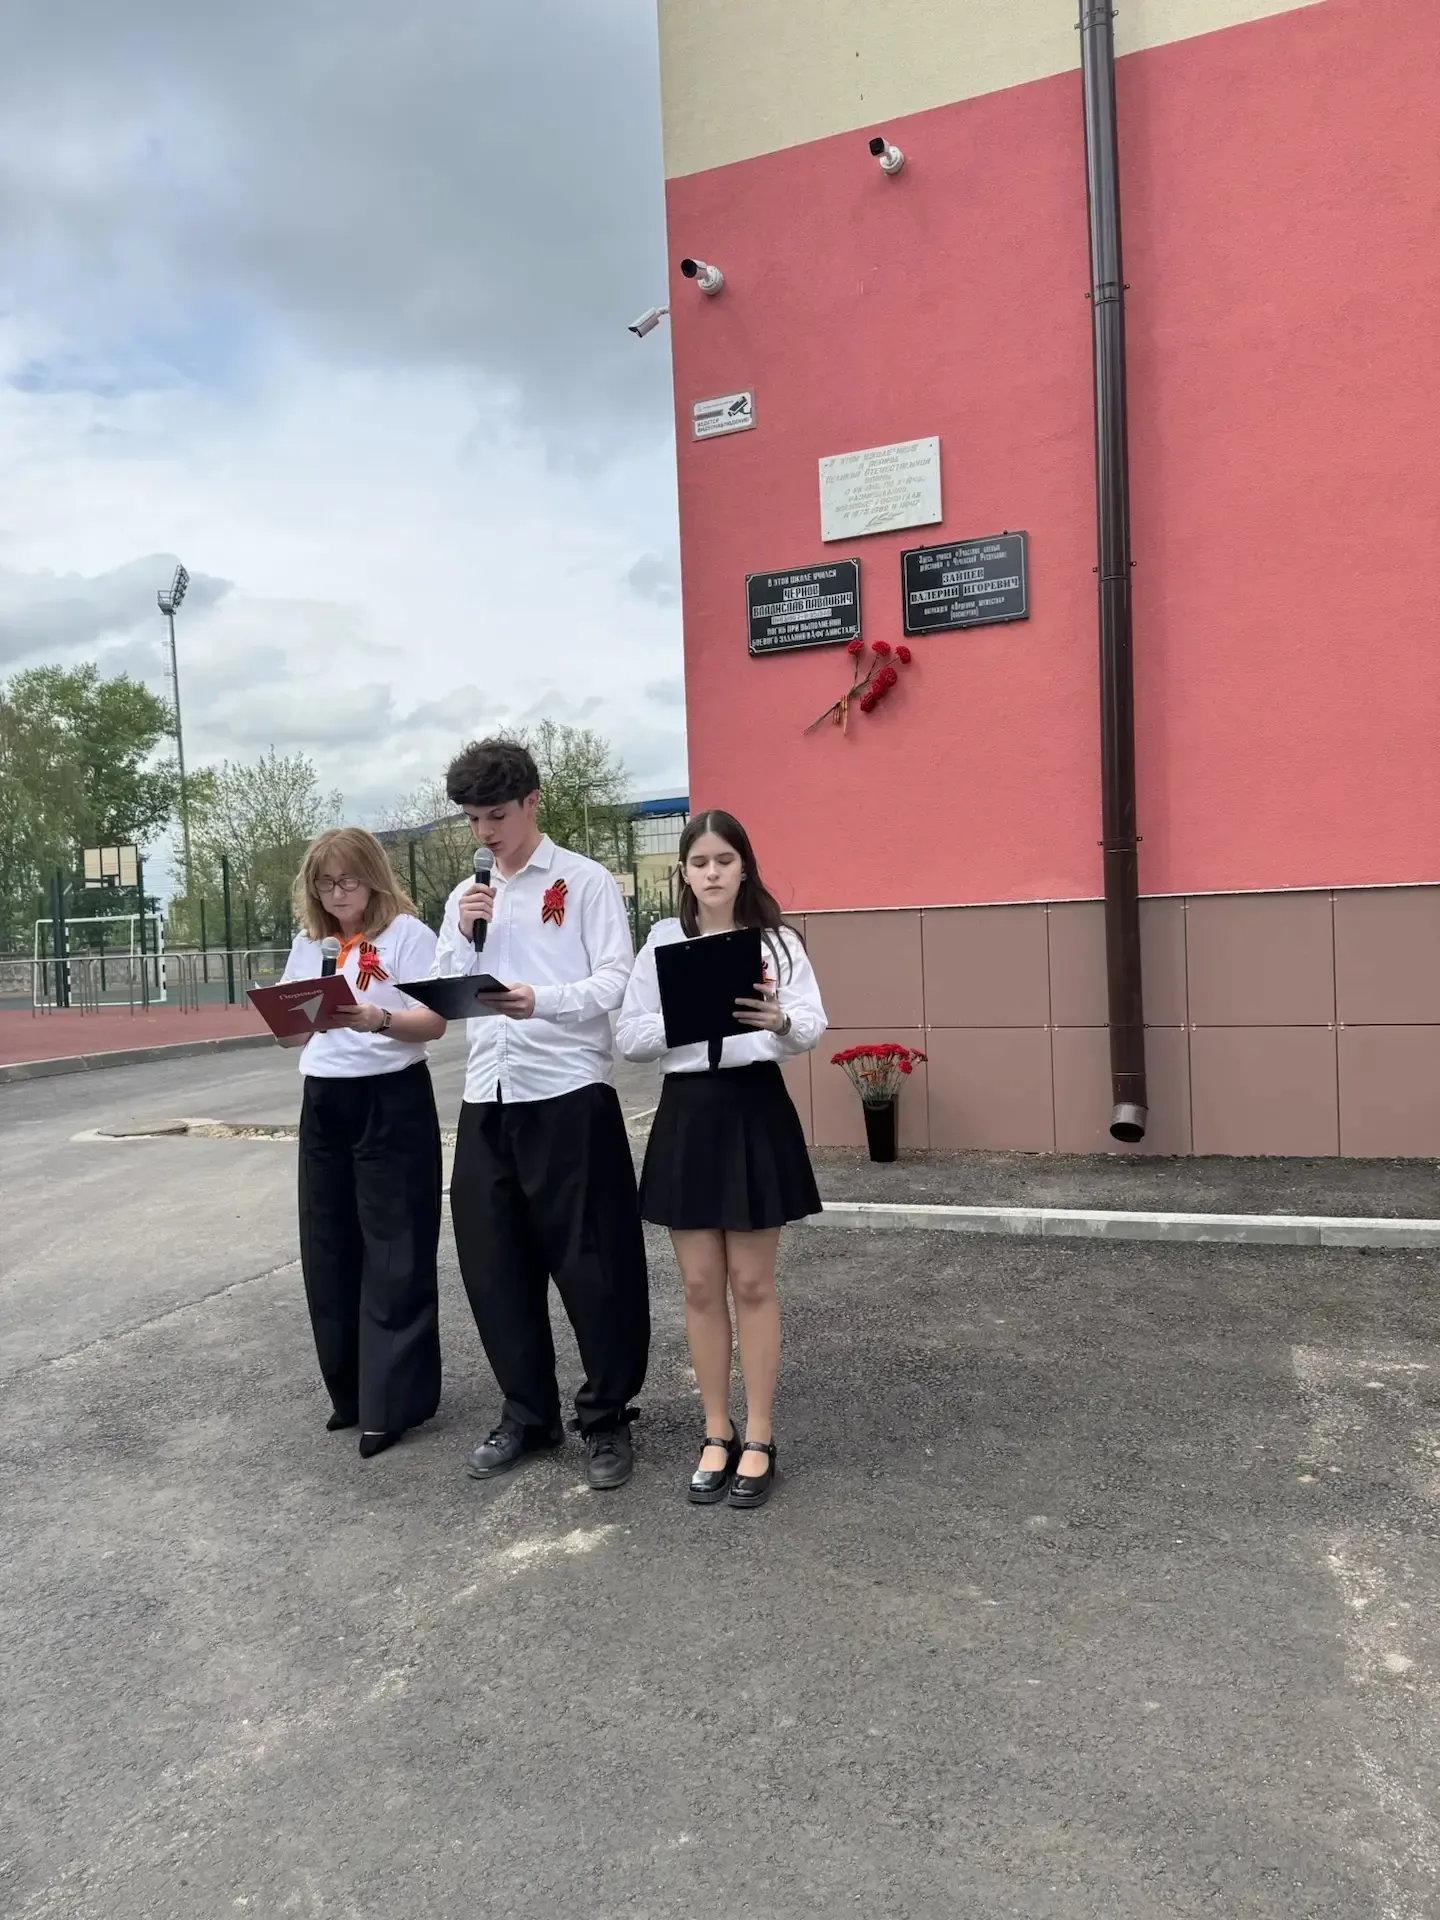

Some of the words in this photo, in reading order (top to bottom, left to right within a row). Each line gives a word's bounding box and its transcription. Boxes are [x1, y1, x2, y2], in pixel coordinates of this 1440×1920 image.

[790, 573, 812, 584] ШКОЛЕ
[813, 569, 837, 580] УЧИЛСЯ
[942, 567, 984, 584] ЗАЙЦЕВ
[784, 584, 819, 599] ЧЕРНОВ
[910, 586, 959, 604] ВАЛЕРИЙ
[963, 577, 1019, 595] ИГОРЕВИЧ
[753, 600, 804, 618] ВЛАДИСЛАВ
[805, 592, 853, 610] ПАВЛОВИЧ
[787, 624, 799, 633] ПРИ
[800, 618, 841, 631] ВЫПОЛНЕНИИ
[752, 636, 778, 647] БОЕВОГО
[811, 625, 857, 639] АФГАНИСТАНЕ
[279, 989, 323, 1000] Первые
